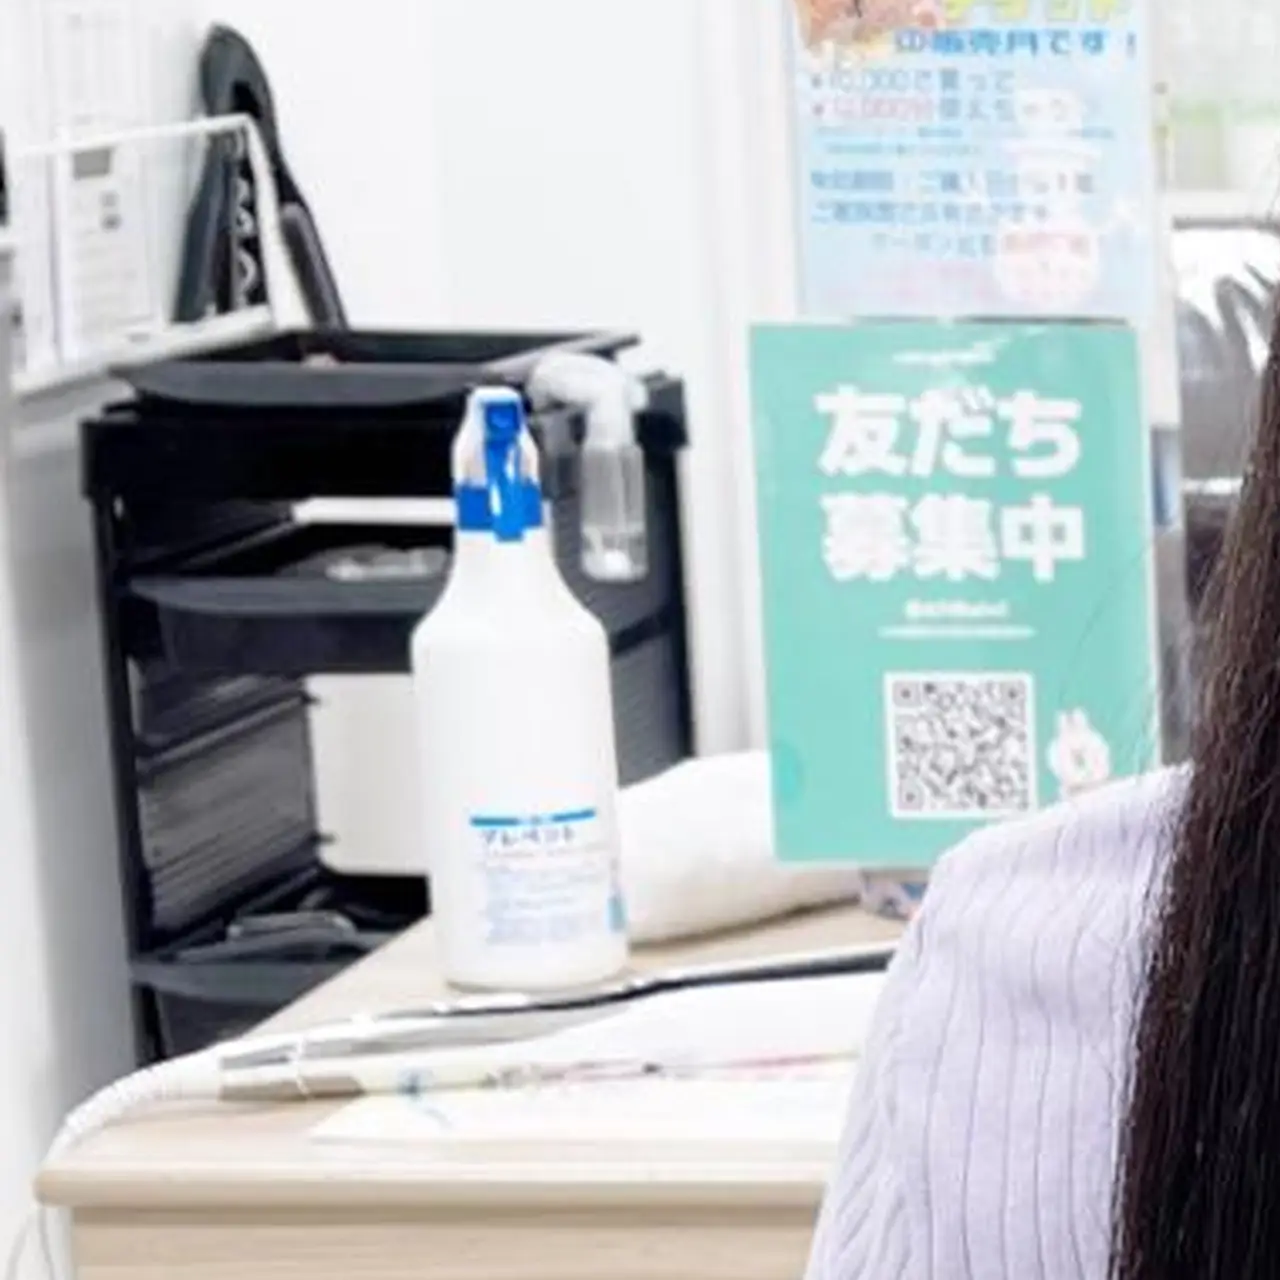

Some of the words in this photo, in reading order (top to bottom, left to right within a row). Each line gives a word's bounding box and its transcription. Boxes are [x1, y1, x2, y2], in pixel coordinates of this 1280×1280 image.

[814, 383, 1083, 478] 友だち
[819, 492, 1086, 582] 募集中
